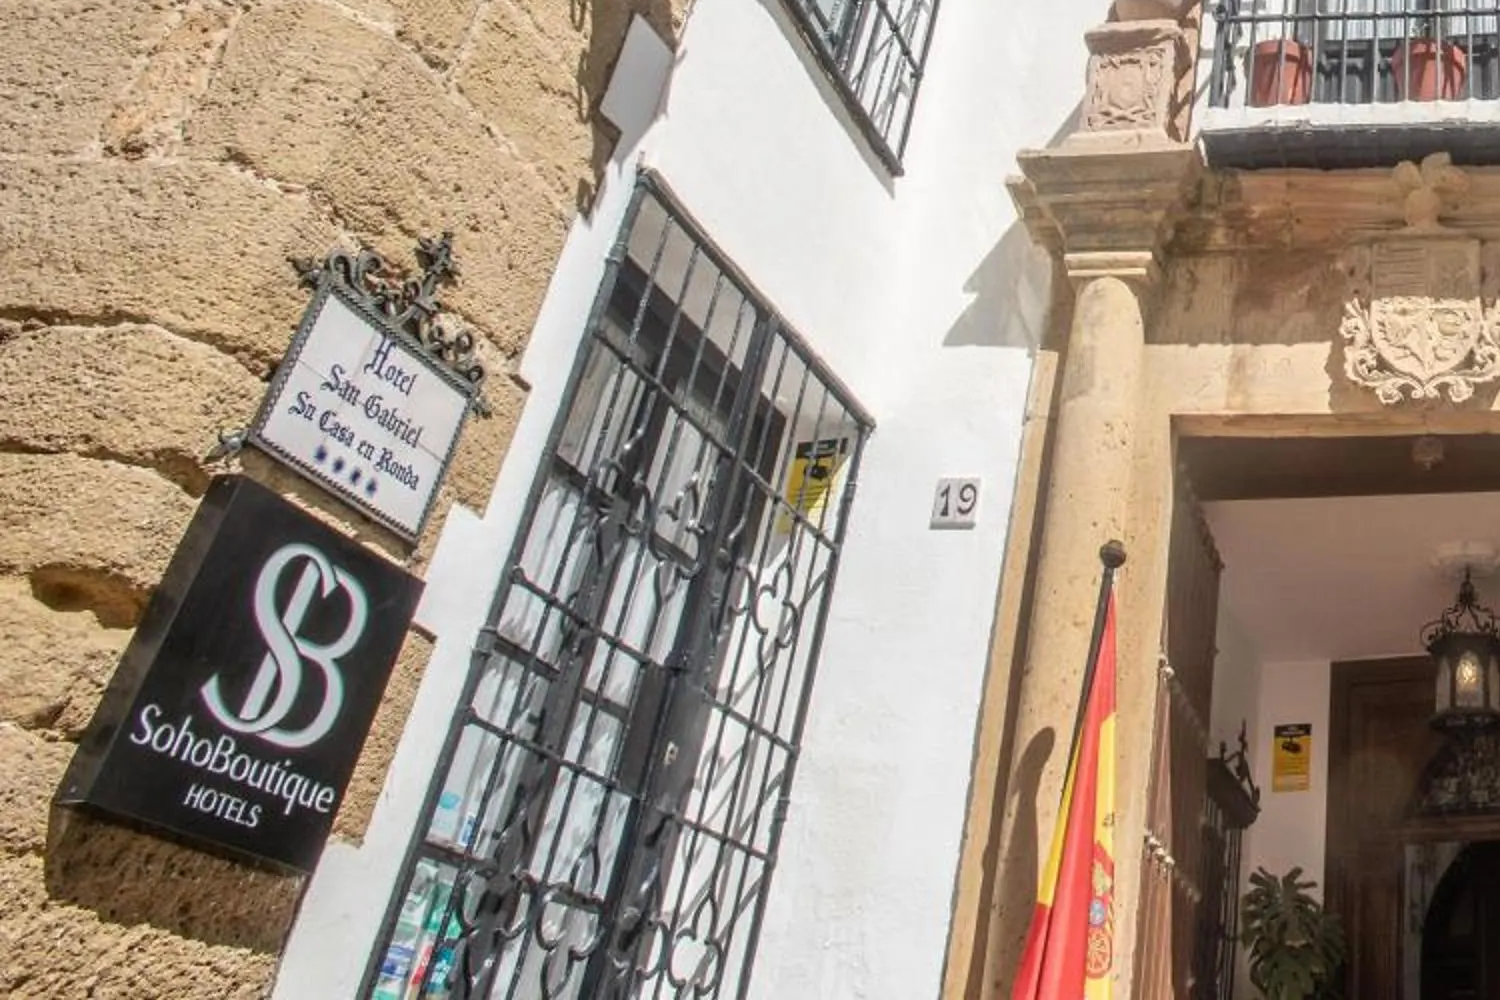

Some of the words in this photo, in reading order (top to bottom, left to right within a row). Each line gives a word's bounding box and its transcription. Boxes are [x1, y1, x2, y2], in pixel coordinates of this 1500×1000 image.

[320, 363, 361, 406] San
[364, 334, 418, 396] Hotel
[288, 391, 317, 421] Su
[319, 409, 356, 447] Casa
[356, 437, 375, 461] en
[375, 446, 420, 491] Ronda
[364, 394, 424, 449] Gabriel
[940, 483, 977, 517] 19
[130, 703, 336, 815] SohoBoutique
[183, 783, 263, 828] HOTELS
